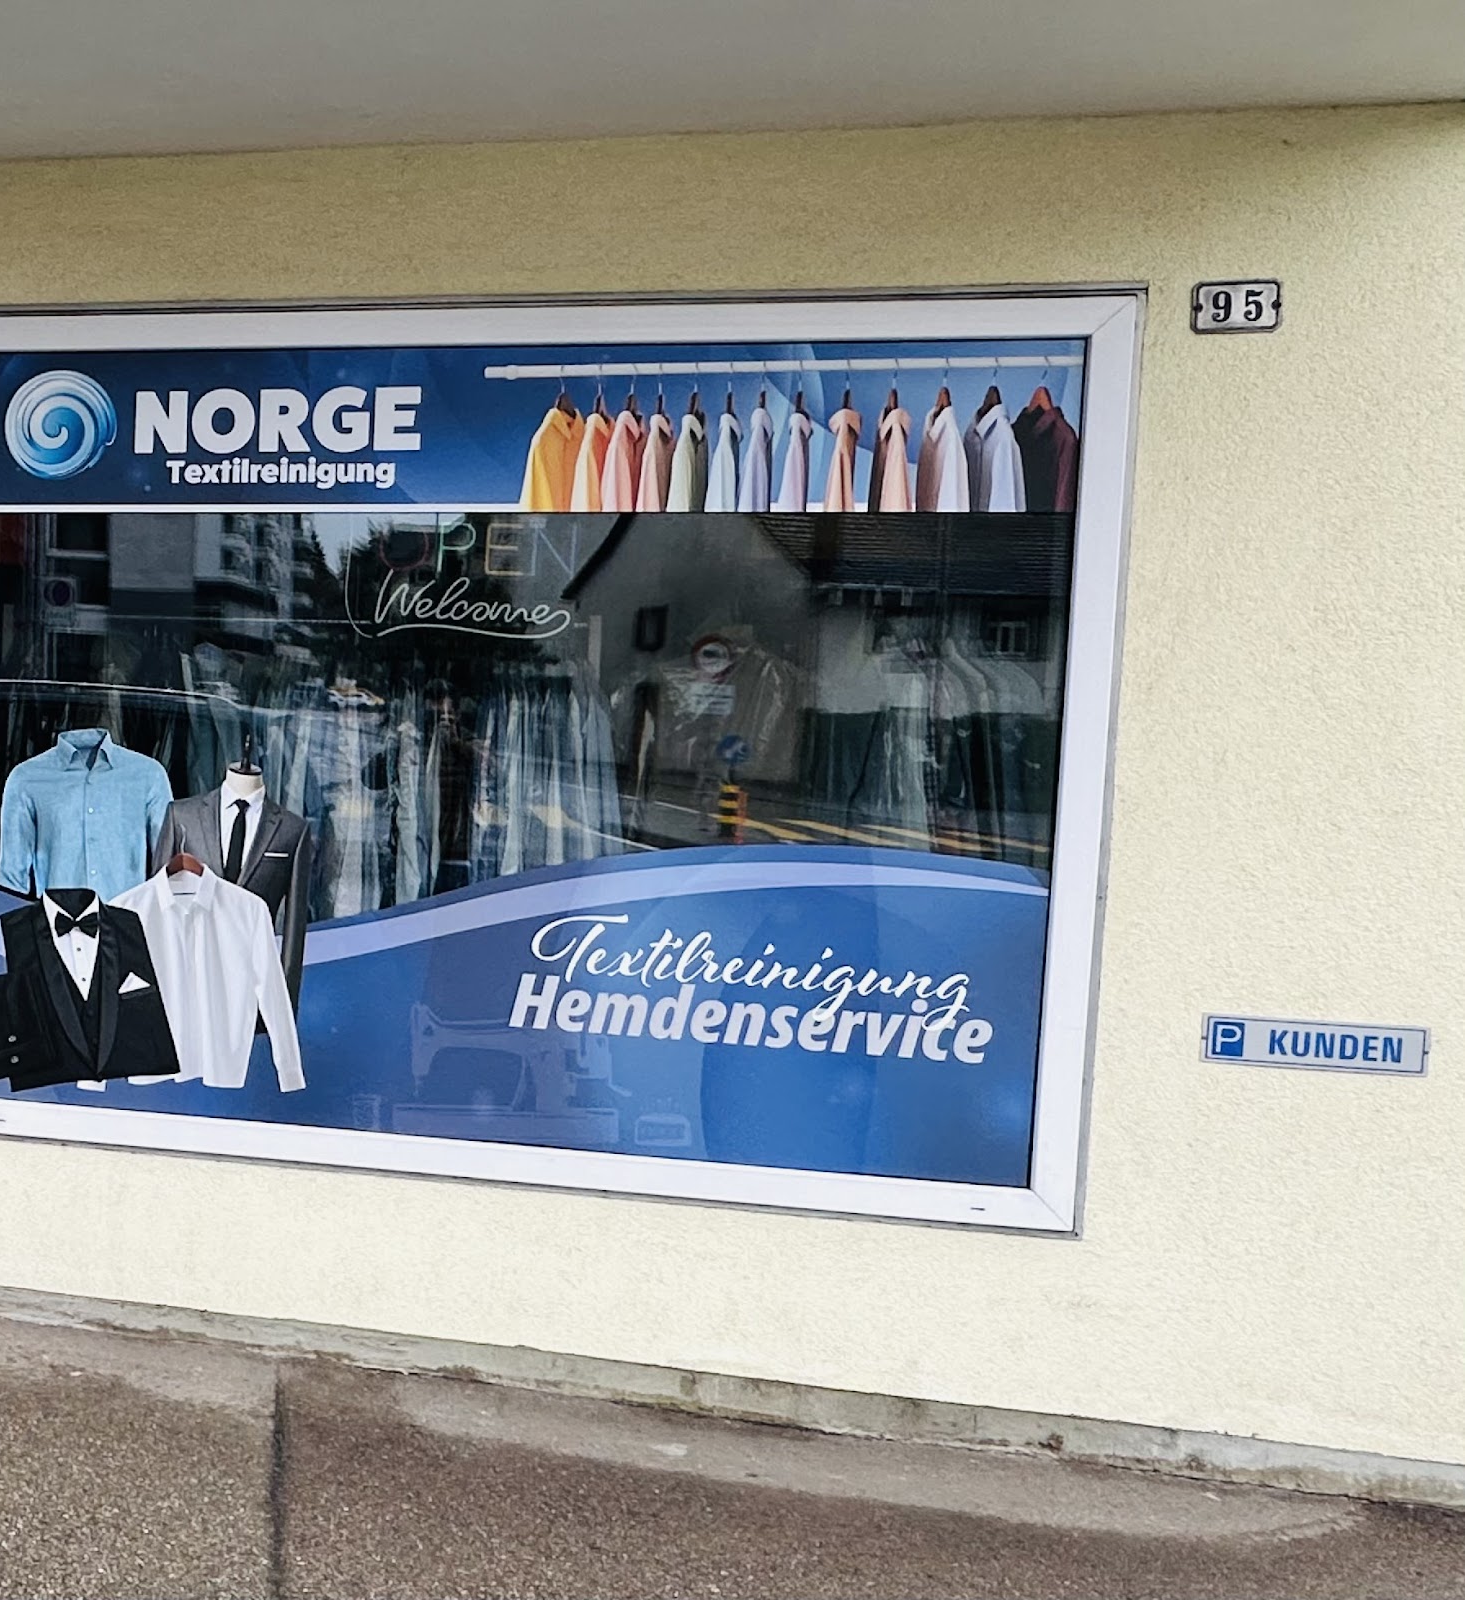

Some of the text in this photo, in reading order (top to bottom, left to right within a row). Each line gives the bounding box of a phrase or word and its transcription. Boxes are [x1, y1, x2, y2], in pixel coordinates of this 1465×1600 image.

[1211, 289, 1264, 323] 95
[133, 385, 423, 456] NORGE
[166, 456, 396, 490] Textilreinigung
[374, 568, 567, 628] Welcome
[530, 914, 971, 1032] Textilreinigung
[508, 973, 995, 1065] Hemdenservice
[1214, 1024, 1404, 1064] P KUNDEN
